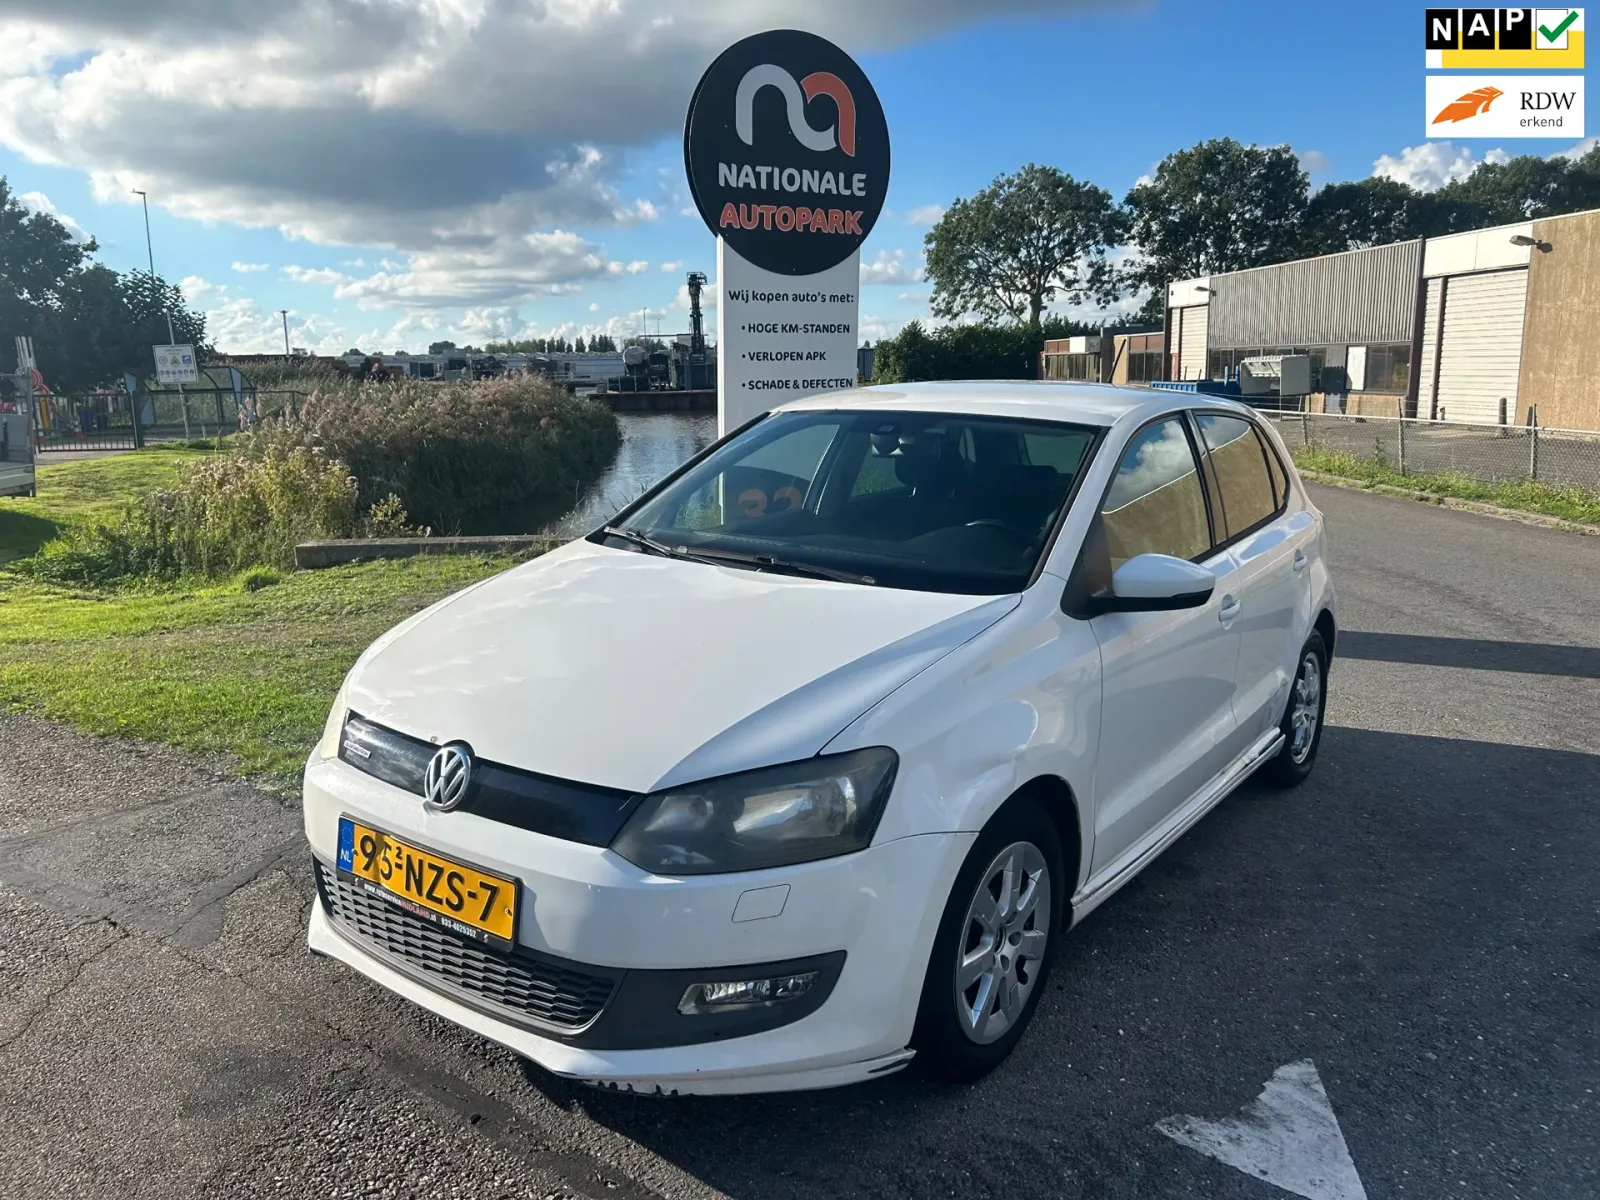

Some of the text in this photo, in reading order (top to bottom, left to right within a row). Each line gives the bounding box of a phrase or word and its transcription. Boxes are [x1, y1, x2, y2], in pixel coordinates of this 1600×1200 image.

[718, 162, 867, 197] NATIONALE
[719, 202, 864, 235] AUTOPARK
[728, 289, 855, 304] Wij kopen auto's met:
[748, 323, 850, 334] HOGE KM-STANDEN
[748, 351, 827, 362] VERLOPEN APK
[748, 378, 853, 391] SCHADE & DEFECTEN
[340, 850, 352, 864] NL
[359, 833, 501, 922] 95-NZS-7
